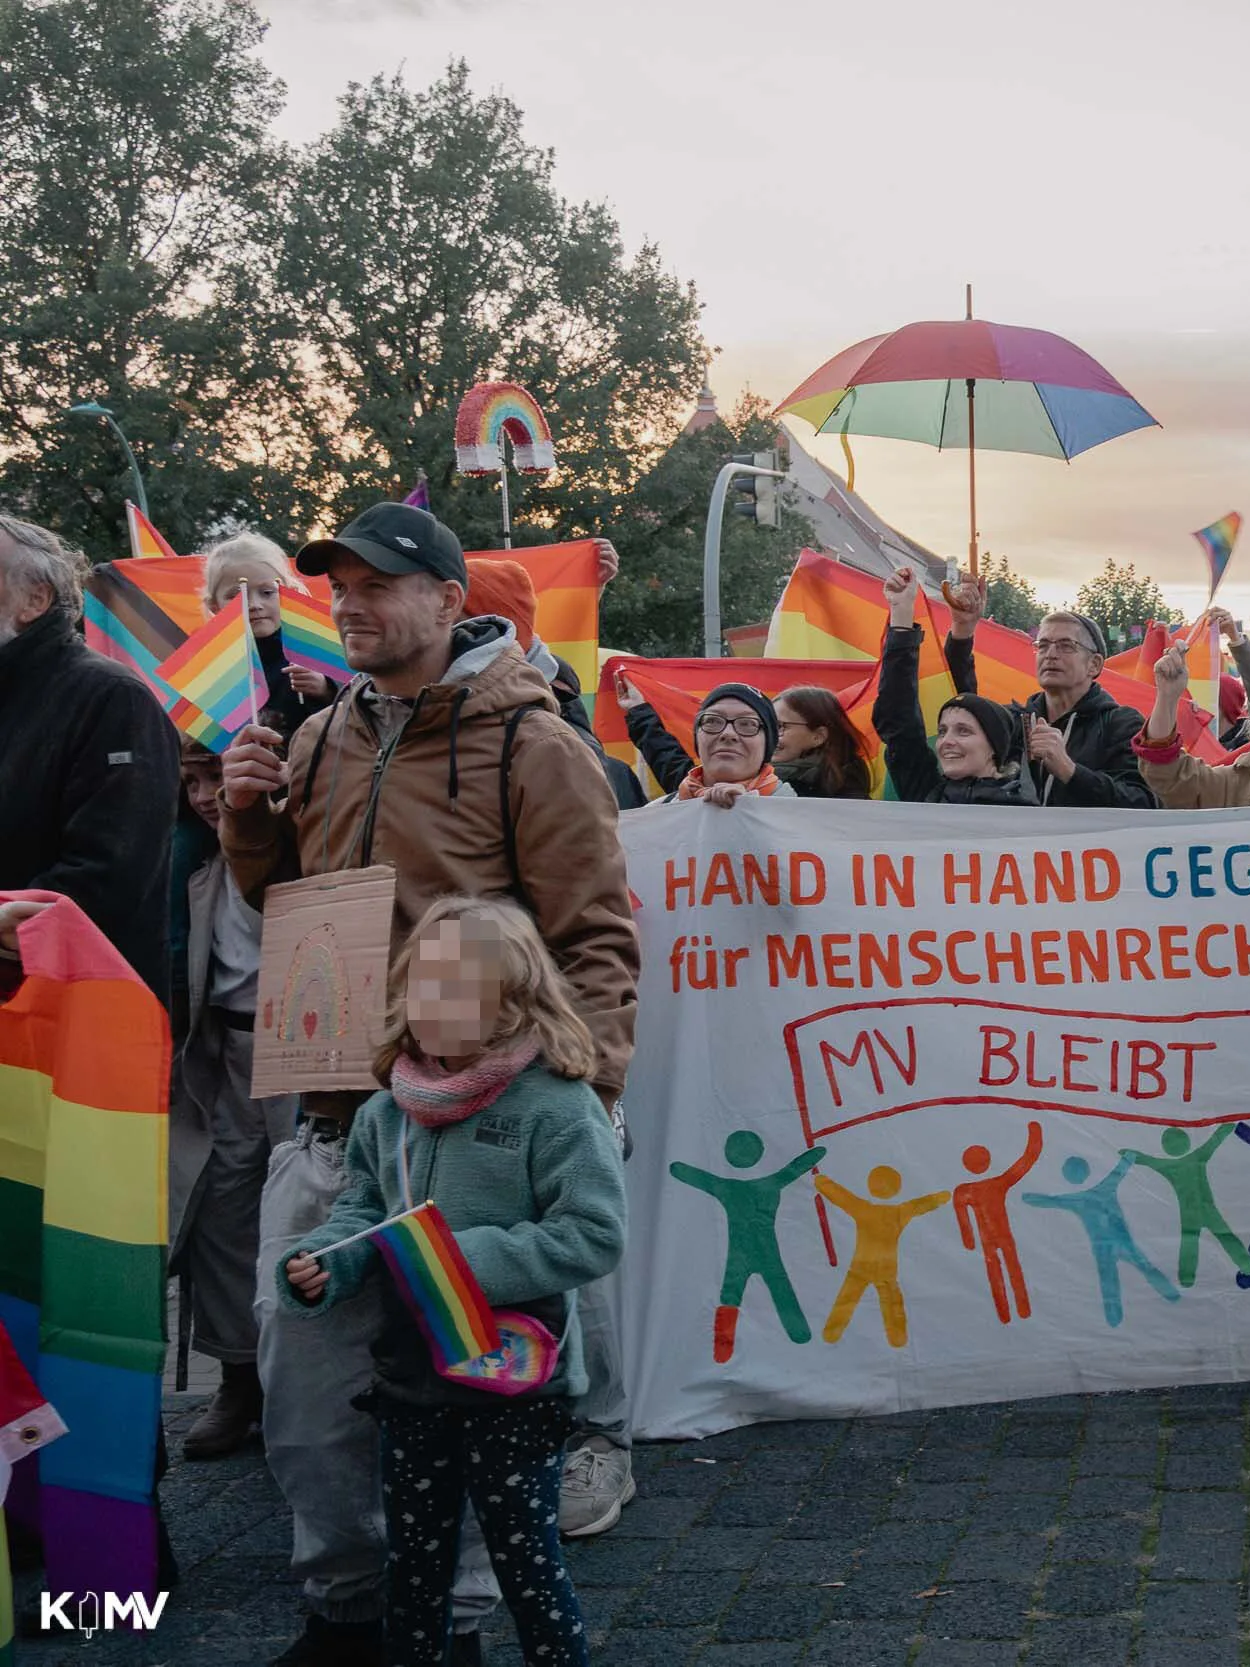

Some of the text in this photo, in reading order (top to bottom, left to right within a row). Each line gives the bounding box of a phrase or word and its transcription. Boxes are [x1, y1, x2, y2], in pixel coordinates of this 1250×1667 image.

[666, 852, 826, 910] HAND
[853, 854, 915, 907] IN
[944, 849, 1121, 905] HAND
[670, 936, 749, 992] für
[820, 1026, 916, 1106] MV
[979, 1026, 1216, 1102] BLEIBT
